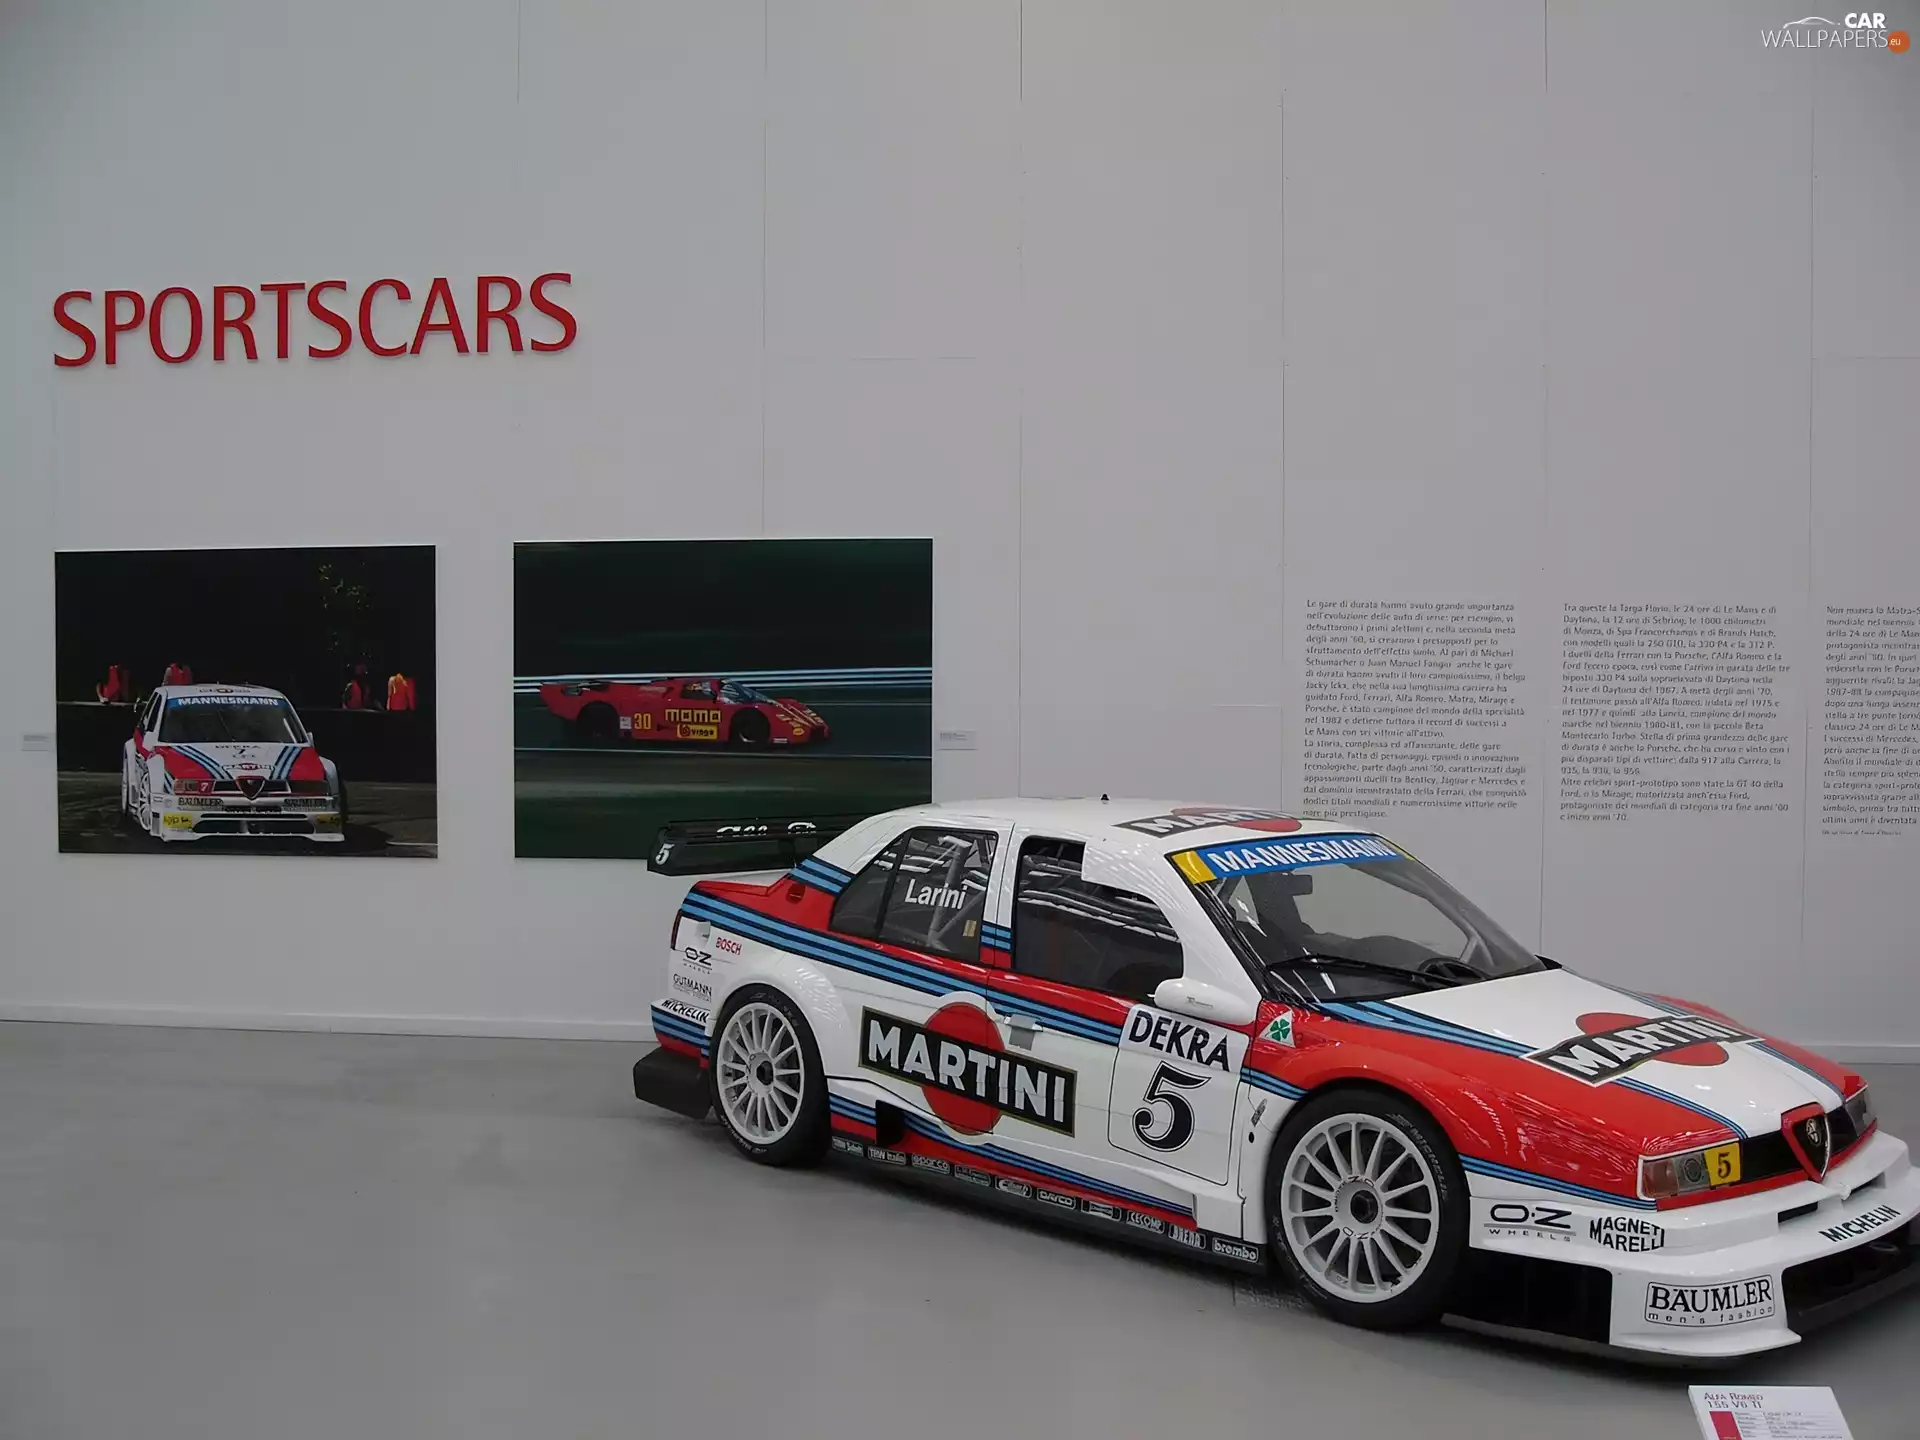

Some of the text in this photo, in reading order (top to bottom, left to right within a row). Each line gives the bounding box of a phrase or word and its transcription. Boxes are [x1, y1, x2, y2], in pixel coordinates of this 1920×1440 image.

[53, 272, 578, 367] SPORTSCARS
[178, 696, 278, 706] MANNESMANN
[634, 713, 652, 730] 30
[655, 843, 675, 865] 5
[1207, 838, 1397, 873] MANNESMANN
[905, 878, 968, 911] Larini
[715, 936, 743, 955] BOSCH
[673, 973, 712, 996] GUTMANN
[661, 999, 710, 1023] MICHELIN
[1128, 1009, 1230, 1073] DEKRA
[1548, 1017, 1746, 1077] MARTINI
[868, 1019, 1067, 1124] MARTINI
[1131, 1060, 1212, 1152] 5
[1717, 1151, 1731, 1178] 5
[1489, 1228, 1571, 1242] WHEELS
[1818, 1205, 1901, 1243] MICHELIN
[1649, 1279, 1772, 1313] BÄUMLER
[1648, 1311, 1706, 1325] men's
